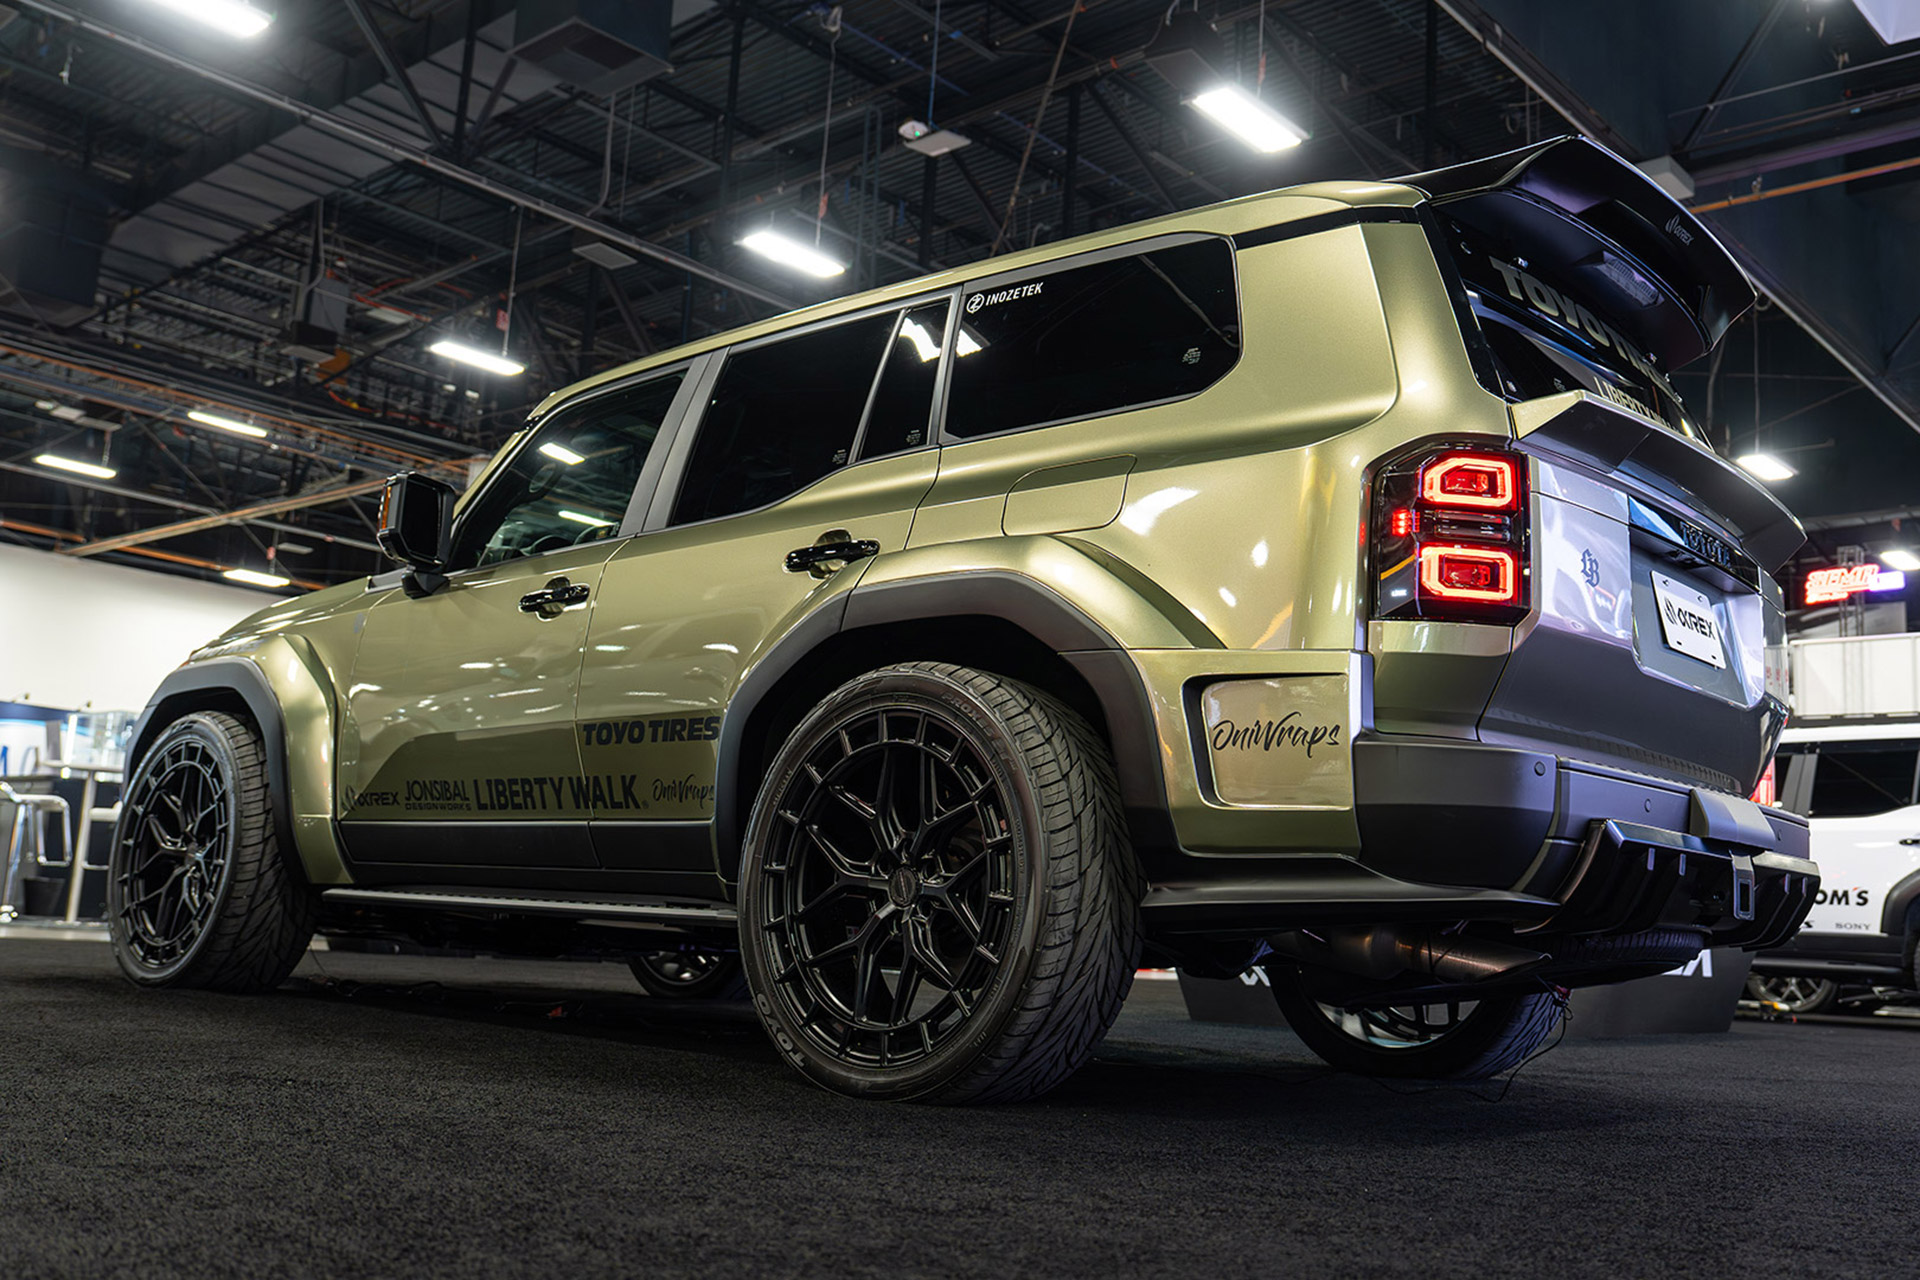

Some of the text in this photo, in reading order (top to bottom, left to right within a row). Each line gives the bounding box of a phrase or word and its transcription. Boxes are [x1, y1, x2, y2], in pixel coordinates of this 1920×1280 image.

[985, 282, 1044, 306] INOZETEK
[1488, 255, 1611, 348] TOYO
[583, 716, 721, 746] TOYO TIRES
[1213, 711, 1340, 759] OniWraps
[405, 780, 470, 802] JONSIBAL
[473, 775, 641, 811] LIBERTY WALK
[1815, 887, 1869, 906] OM'S
[1835, 922, 1871, 930] SONY
